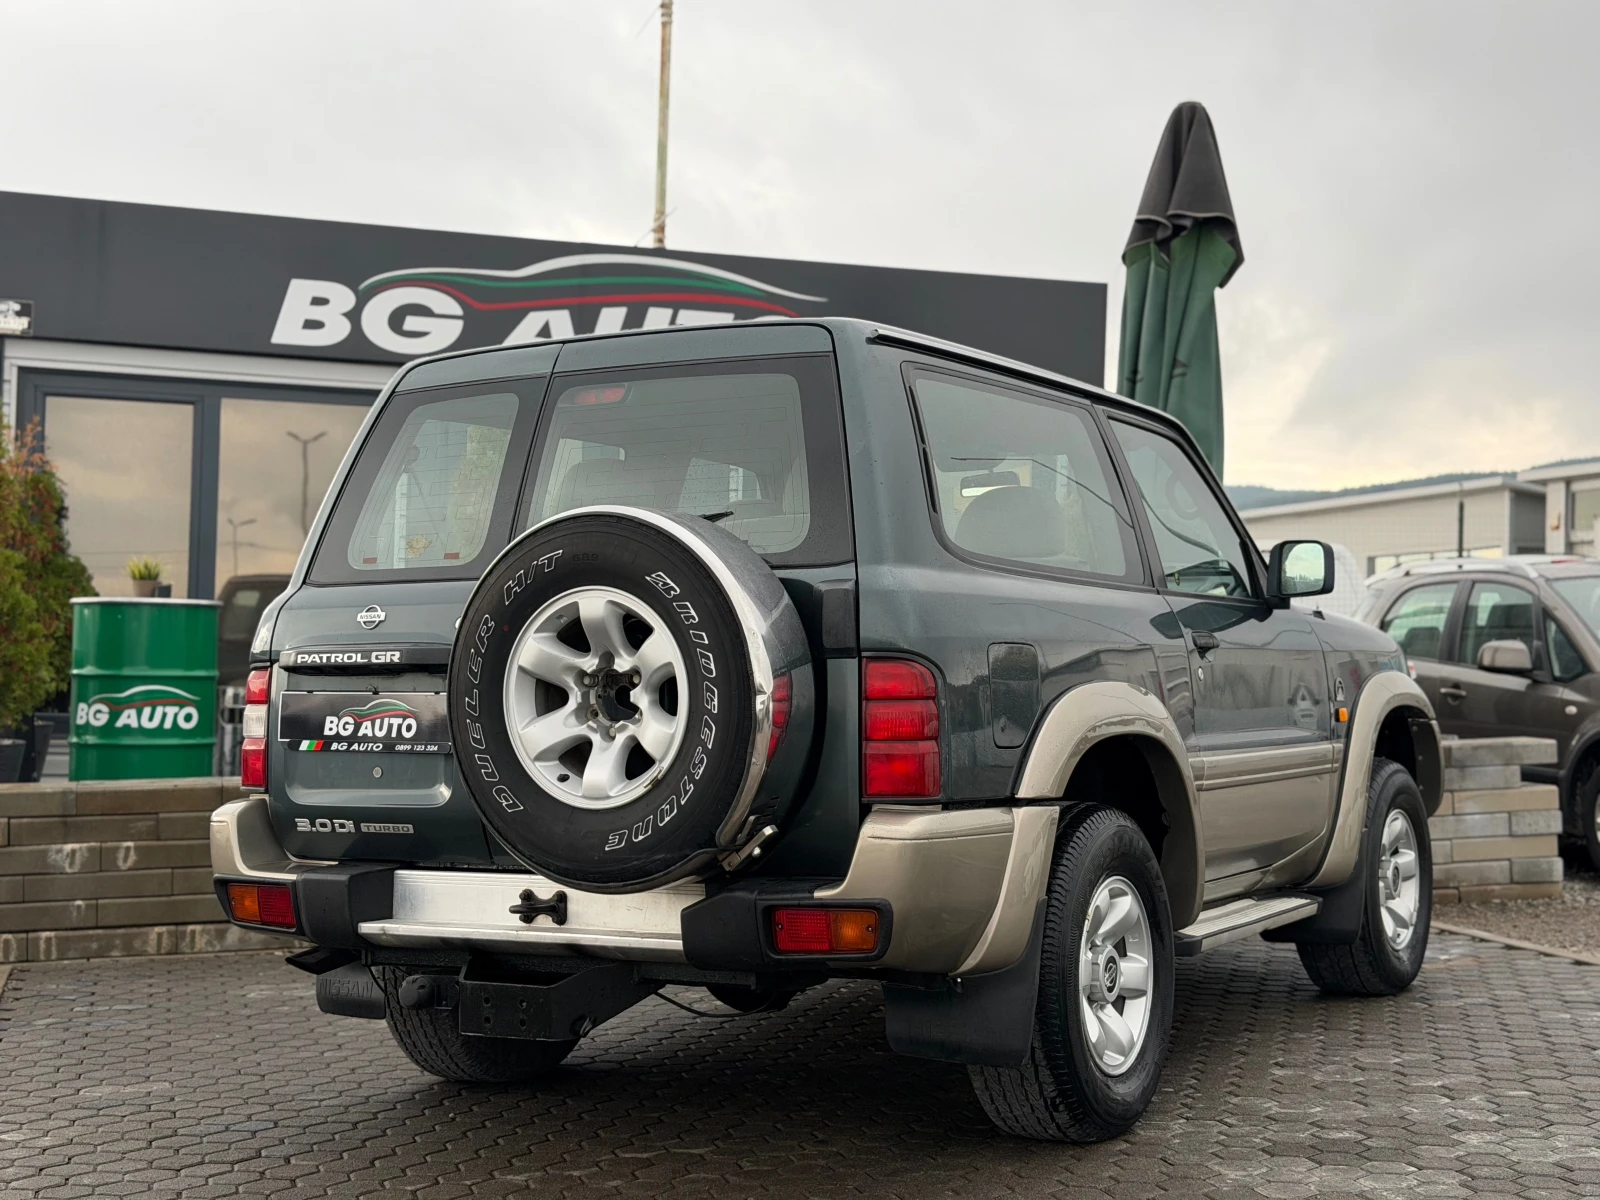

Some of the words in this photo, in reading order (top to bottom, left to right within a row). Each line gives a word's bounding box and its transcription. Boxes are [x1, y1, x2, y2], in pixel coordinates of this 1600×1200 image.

[270, 278, 464, 355] BG
[504, 549, 563, 605] H/T
[297, 653, 368, 663] PATROL
[370, 651, 400, 663] GR
[76, 702, 110, 727] BG
[115, 706, 199, 730] AUTO
[465, 613, 524, 813] DUELER
[605, 571, 718, 851] BRIDGESTONE
[323, 716, 355, 736] BG
[357, 717, 417, 738] AUTO
[350, 743, 383, 751] AUTO
[362, 824, 411, 833] TURBO
[318, 978, 374, 998] NISSAN
